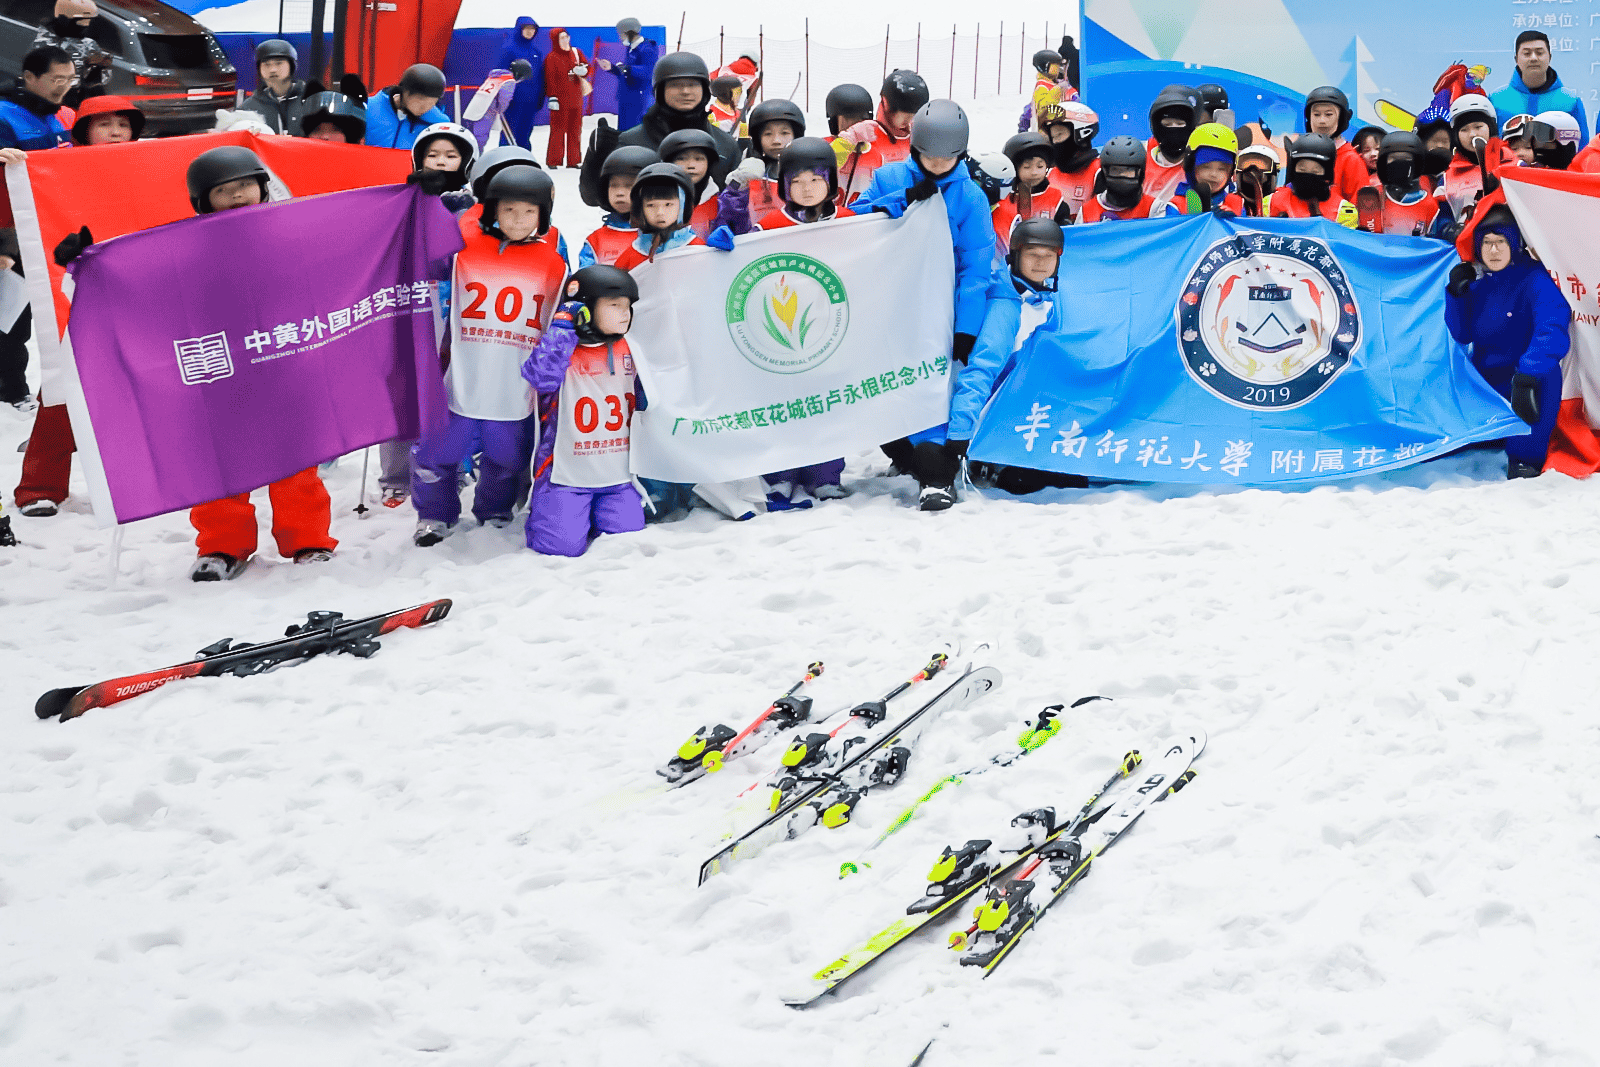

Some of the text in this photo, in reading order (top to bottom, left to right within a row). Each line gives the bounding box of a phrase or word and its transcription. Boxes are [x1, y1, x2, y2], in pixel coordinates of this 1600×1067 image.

[244, 280, 431, 354] 中黄外国语实验学
[461, 282, 546, 331] 201
[769, 358, 808, 367] MEMORIAL
[808, 338, 835, 362] PRIMARY
[672, 355, 949, 436] 广州市花都区花城街卢永根纪念小学
[1242, 387, 1291, 403] 2019
